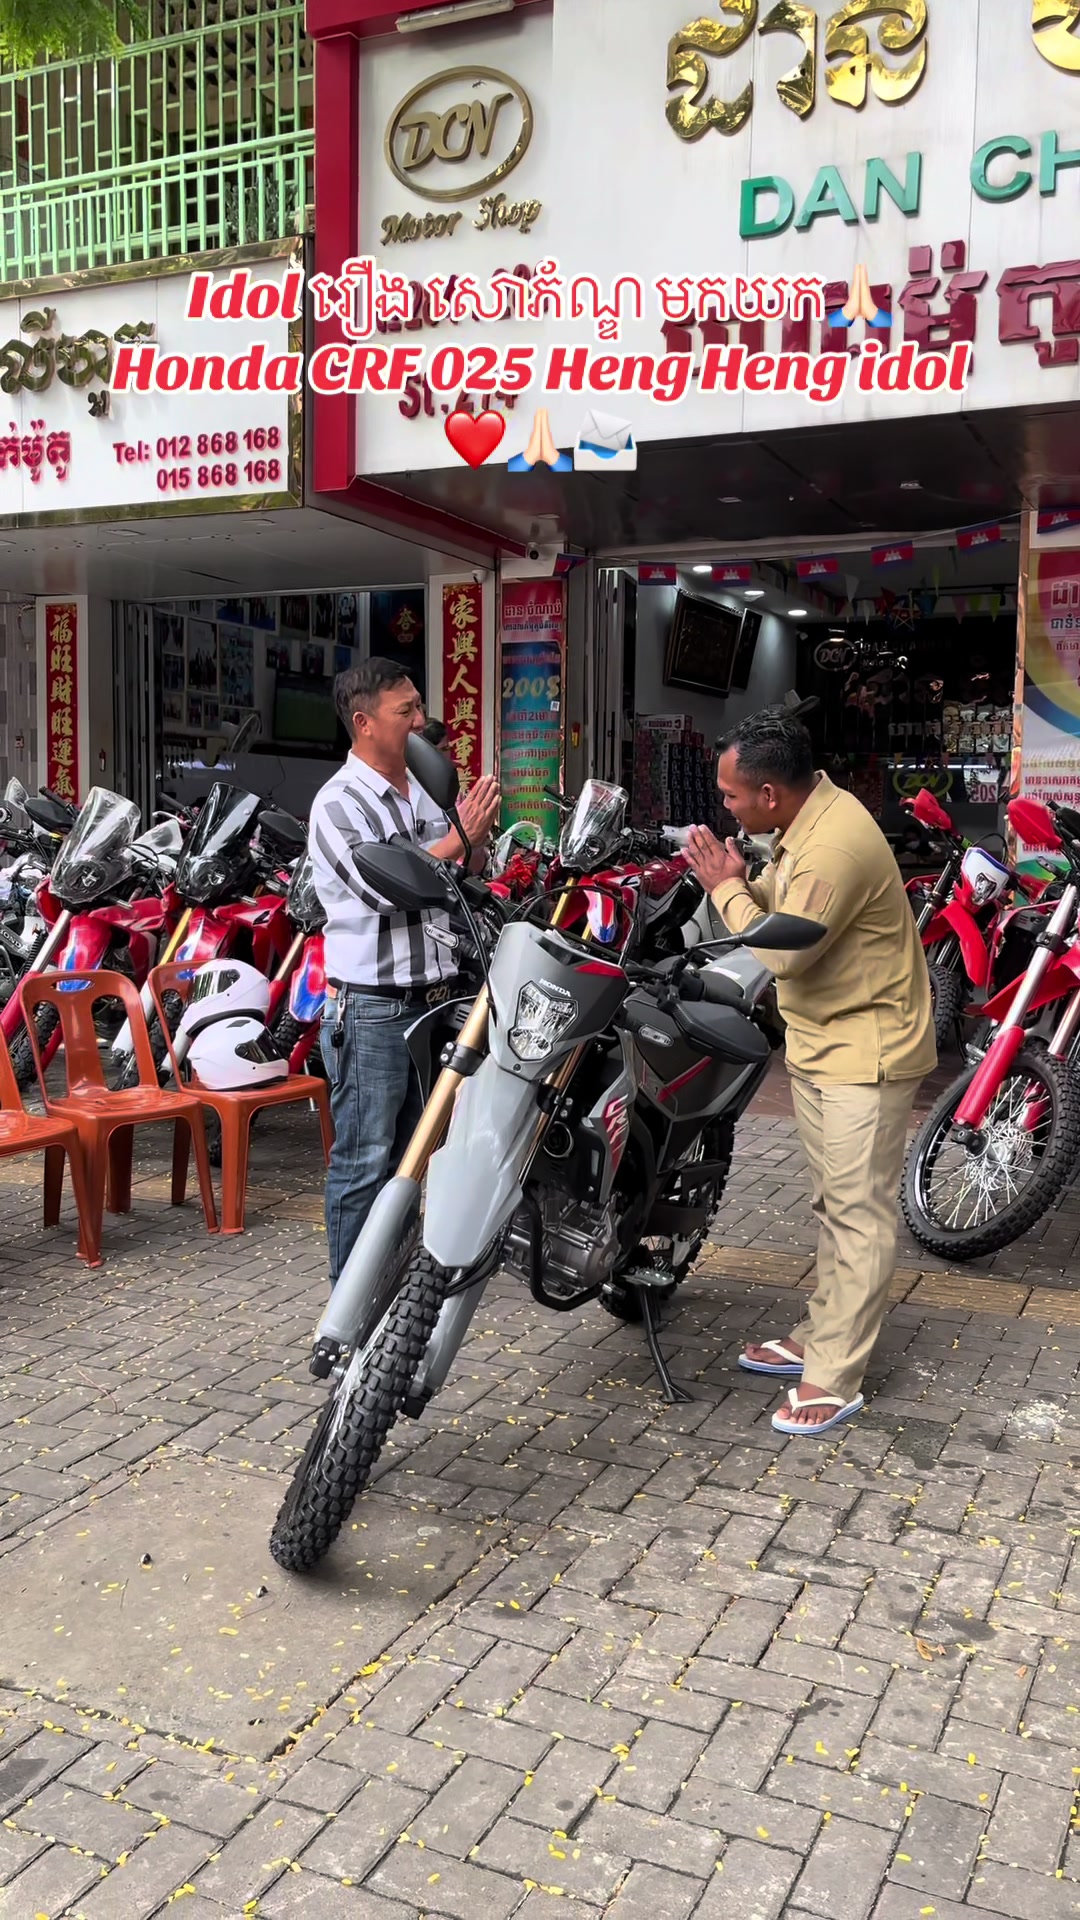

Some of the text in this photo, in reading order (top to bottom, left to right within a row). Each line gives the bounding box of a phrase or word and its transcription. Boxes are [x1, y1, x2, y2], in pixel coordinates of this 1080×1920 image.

[399, 93, 514, 171] DCN
[740, 129, 1080, 240] DAN CH
[380, 192, 542, 246] Motor Shop
[113, 426, 280, 464] Tel: 012 868 168
[156, 458, 280, 491] 015 868 168
[502, 675, 560, 699] 200$
[539, 978, 571, 997] HONDA
